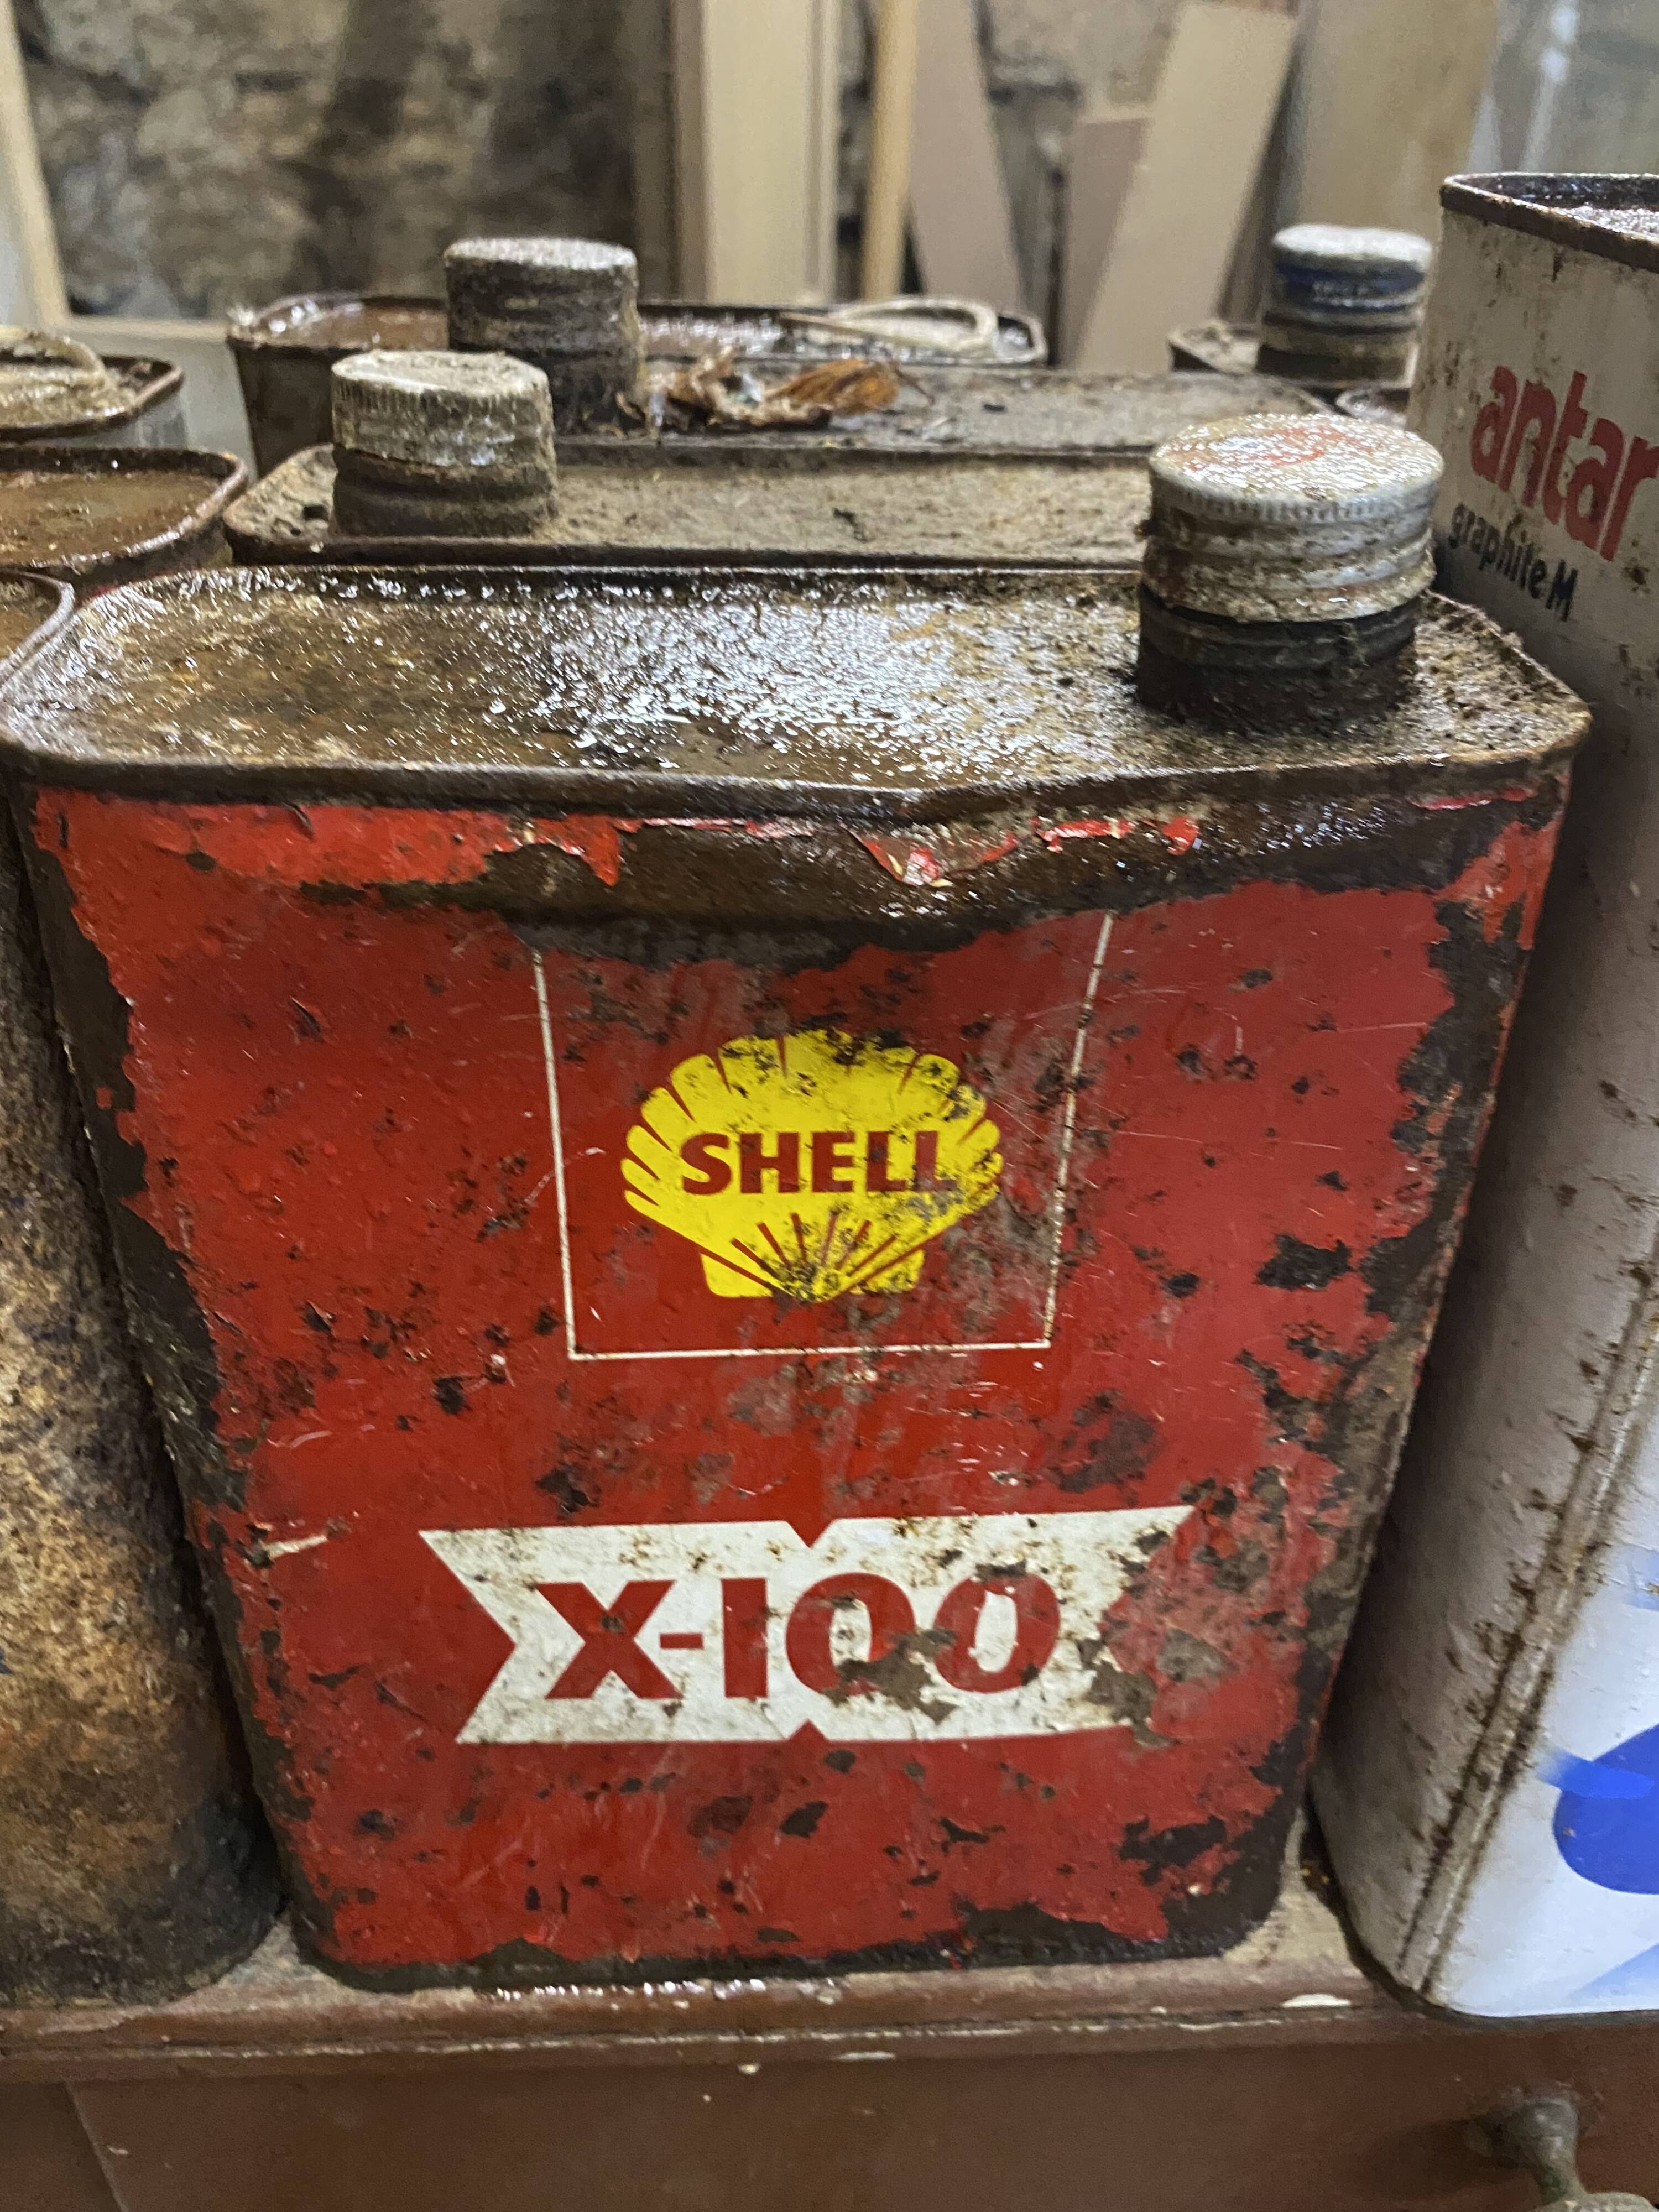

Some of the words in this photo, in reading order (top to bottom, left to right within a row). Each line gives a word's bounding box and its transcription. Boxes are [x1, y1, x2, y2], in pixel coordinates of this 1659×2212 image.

[1471, 366, 1659, 562] antar
[1448, 502, 1548, 599] graphite
[1546, 560, 1578, 622] M
[681, 1130, 959, 1196] SHELL
[535, 1572, 1061, 1699] X-100
